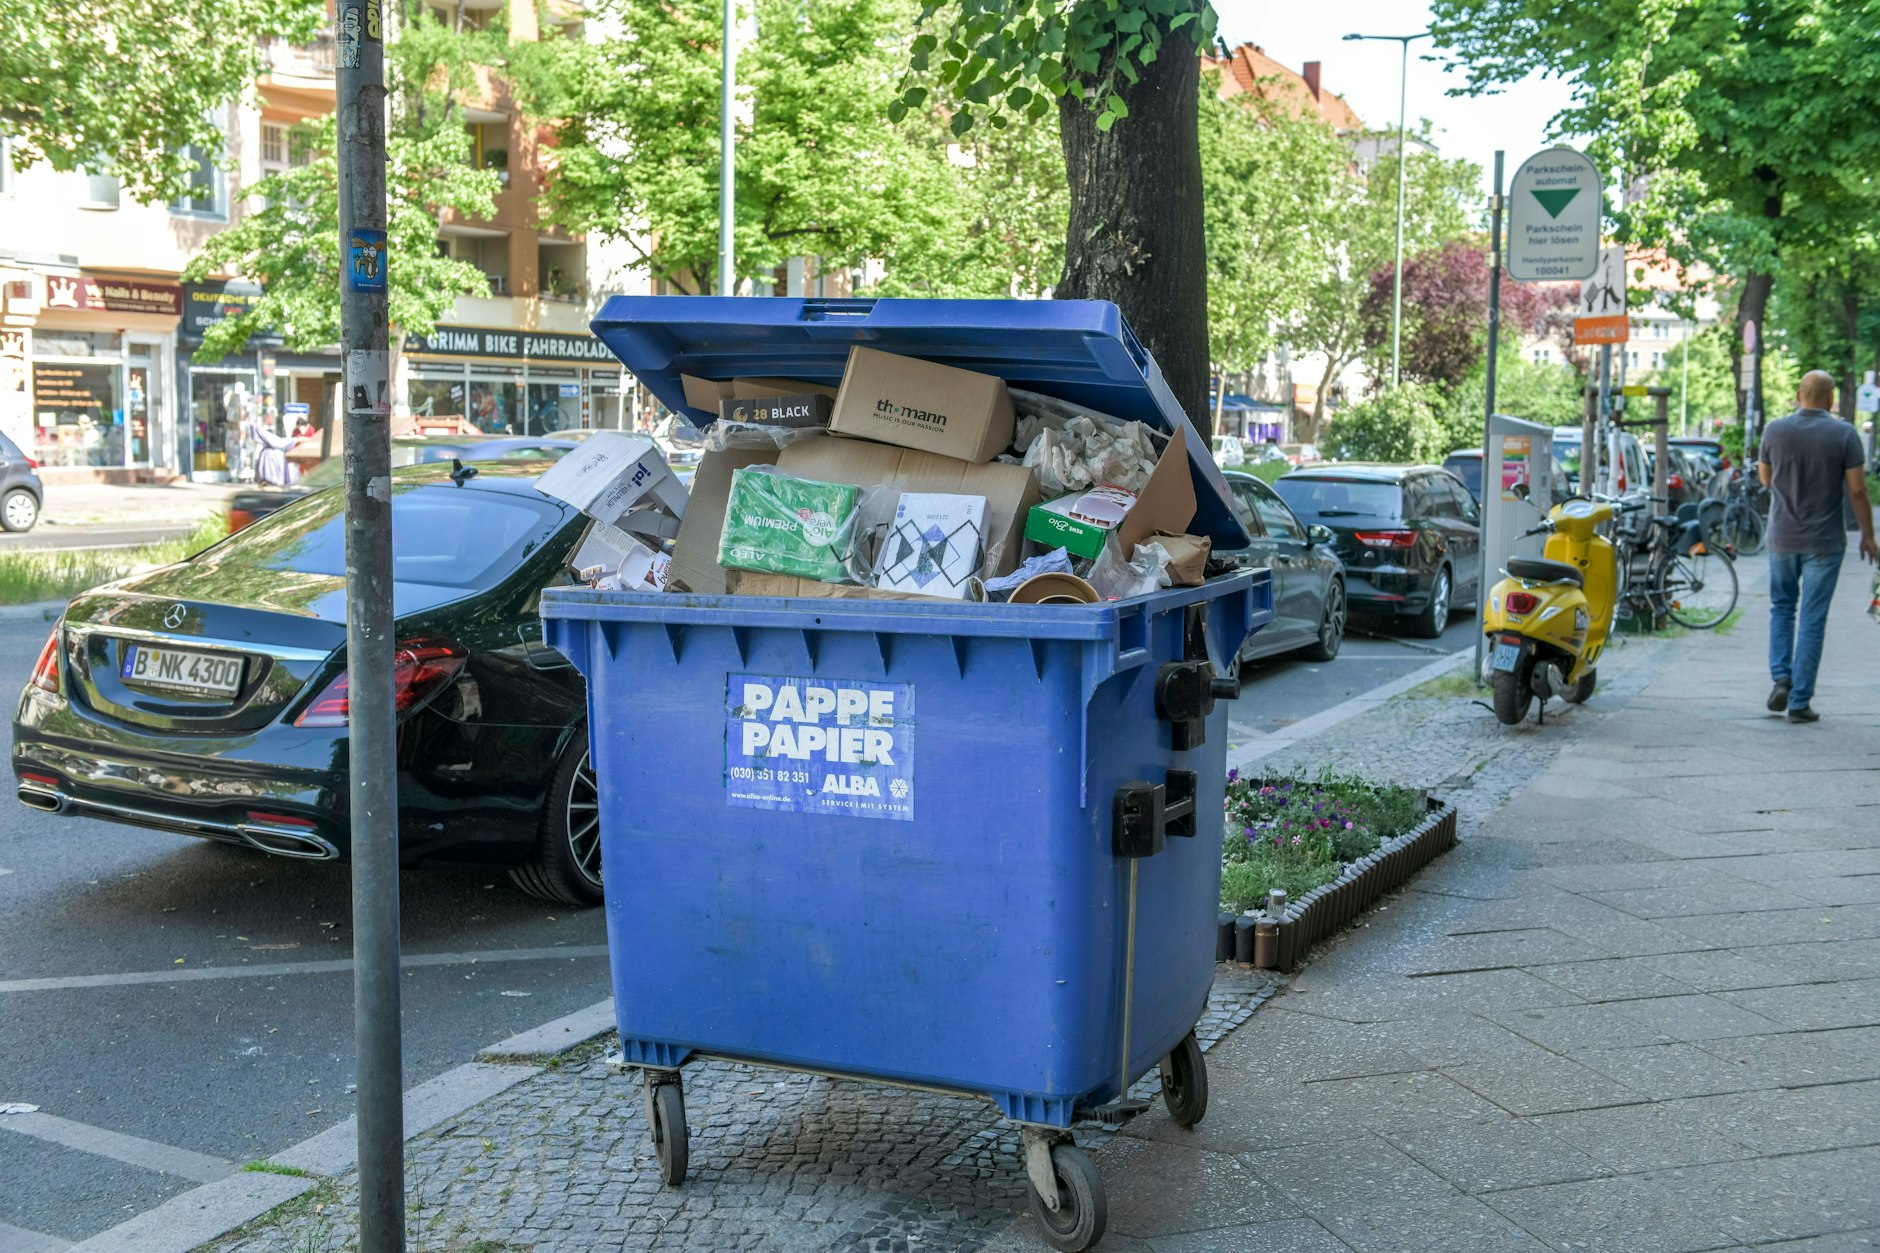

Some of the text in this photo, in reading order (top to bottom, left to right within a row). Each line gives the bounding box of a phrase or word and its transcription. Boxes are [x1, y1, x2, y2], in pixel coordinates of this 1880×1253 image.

[1526, 164, 1587, 174] Parkschein-
[1535, 177, 1577, 186] automat
[1525, 224, 1583, 233] Parkschein
[1528, 236, 1579, 245] hier lösen
[1522, 256, 1584, 265] Handyparkzone
[1535, 266, 1569, 275] 100041
[426, 331, 619, 360] GRIMM BIKE FAHRRADLADE
[753, 405, 810, 420] 28 BLACK
[872, 412, 893, 422] MUSIC
[917, 422, 945, 433] PASSION
[744, 514, 798, 531] PREMIUM
[809, 518, 832, 528] vera
[1048, 518, 1069, 532] Bio
[134, 651, 240, 687] B NK 4300
[743, 683, 894, 727] PAPPE
[742, 722, 895, 765] PAPIER
[730, 766, 809, 784] (030) 351 82 351
[822, 773, 881, 797] ALBA
[821, 799, 854, 808] SERVICE
[878, 803, 909, 812] SYSTEM
